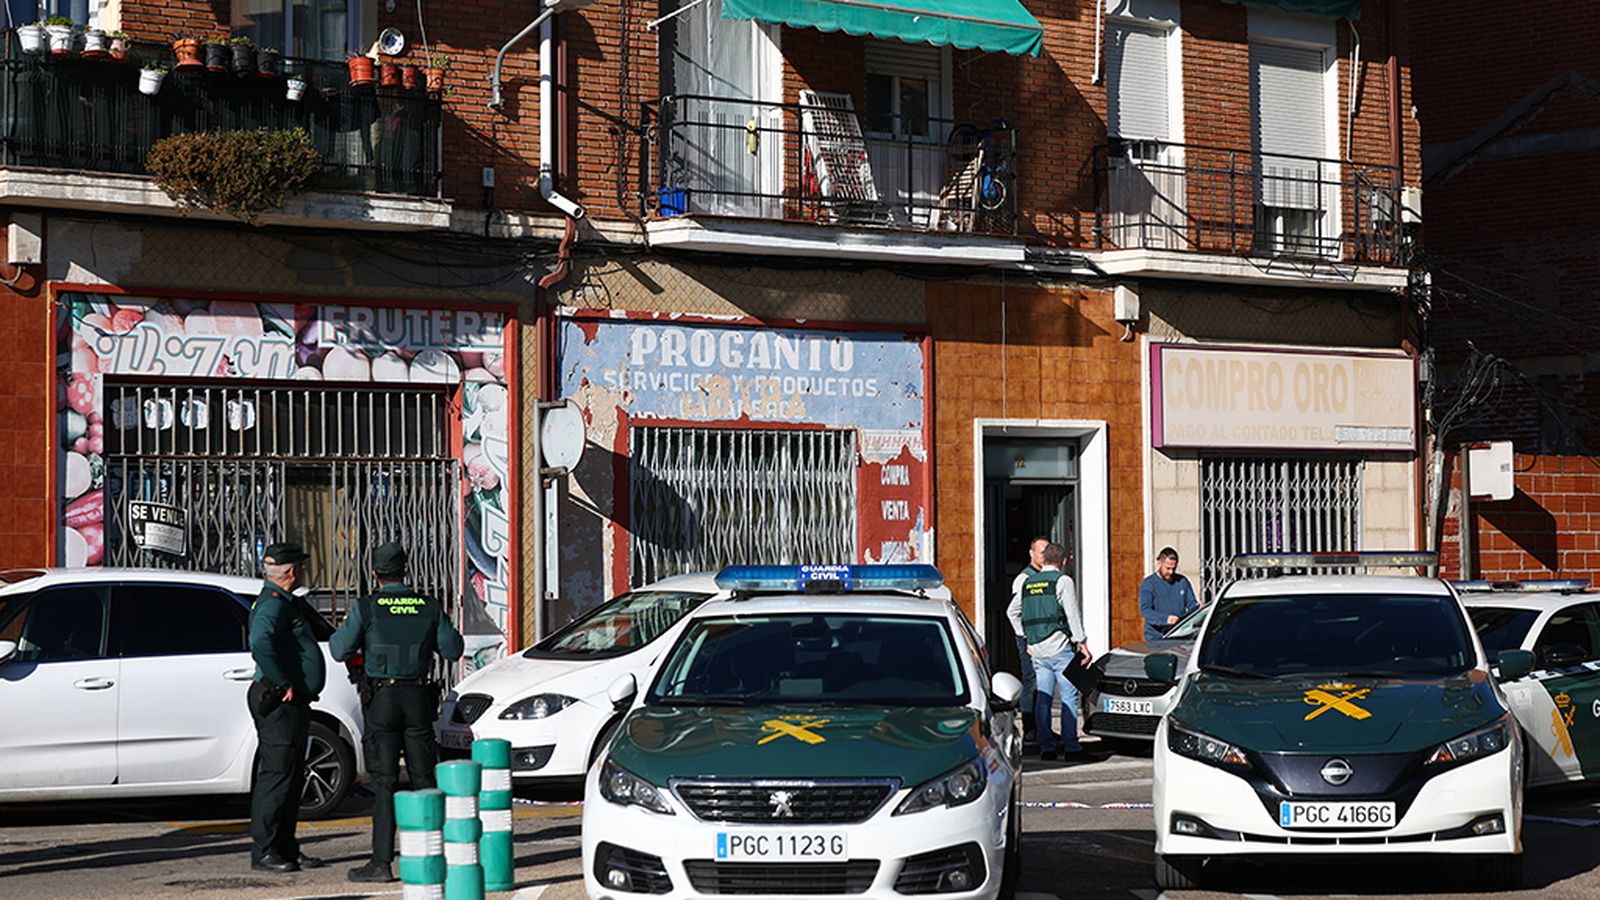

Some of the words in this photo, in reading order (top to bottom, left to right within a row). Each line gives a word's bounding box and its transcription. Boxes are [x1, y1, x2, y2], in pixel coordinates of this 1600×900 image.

[629, 326, 855, 372] PROGANTO
[755, 375, 879, 398] PRODUCTOS
[1166, 357, 1284, 413] COMPRO
[1293, 362, 1348, 414] ORO
[1168, 424, 1206, 440] PAGO
[1211, 424, 1228, 440] AL
[1232, 424, 1297, 441] CONTADO
[132, 504, 148, 519] SE
[881, 500, 910, 520] VENTA
[801, 565, 849, 573] GUARDIA
[810, 572, 840, 580] CIVIL
[377, 597, 426, 605] GUARDIA
[390, 606, 419, 614] CIVIL
[1133, 703, 1150, 714] LXC
[1293, 806, 1330, 823] PGC
[730, 835, 769, 855] PGC
[776, 835, 826, 855] 1123
